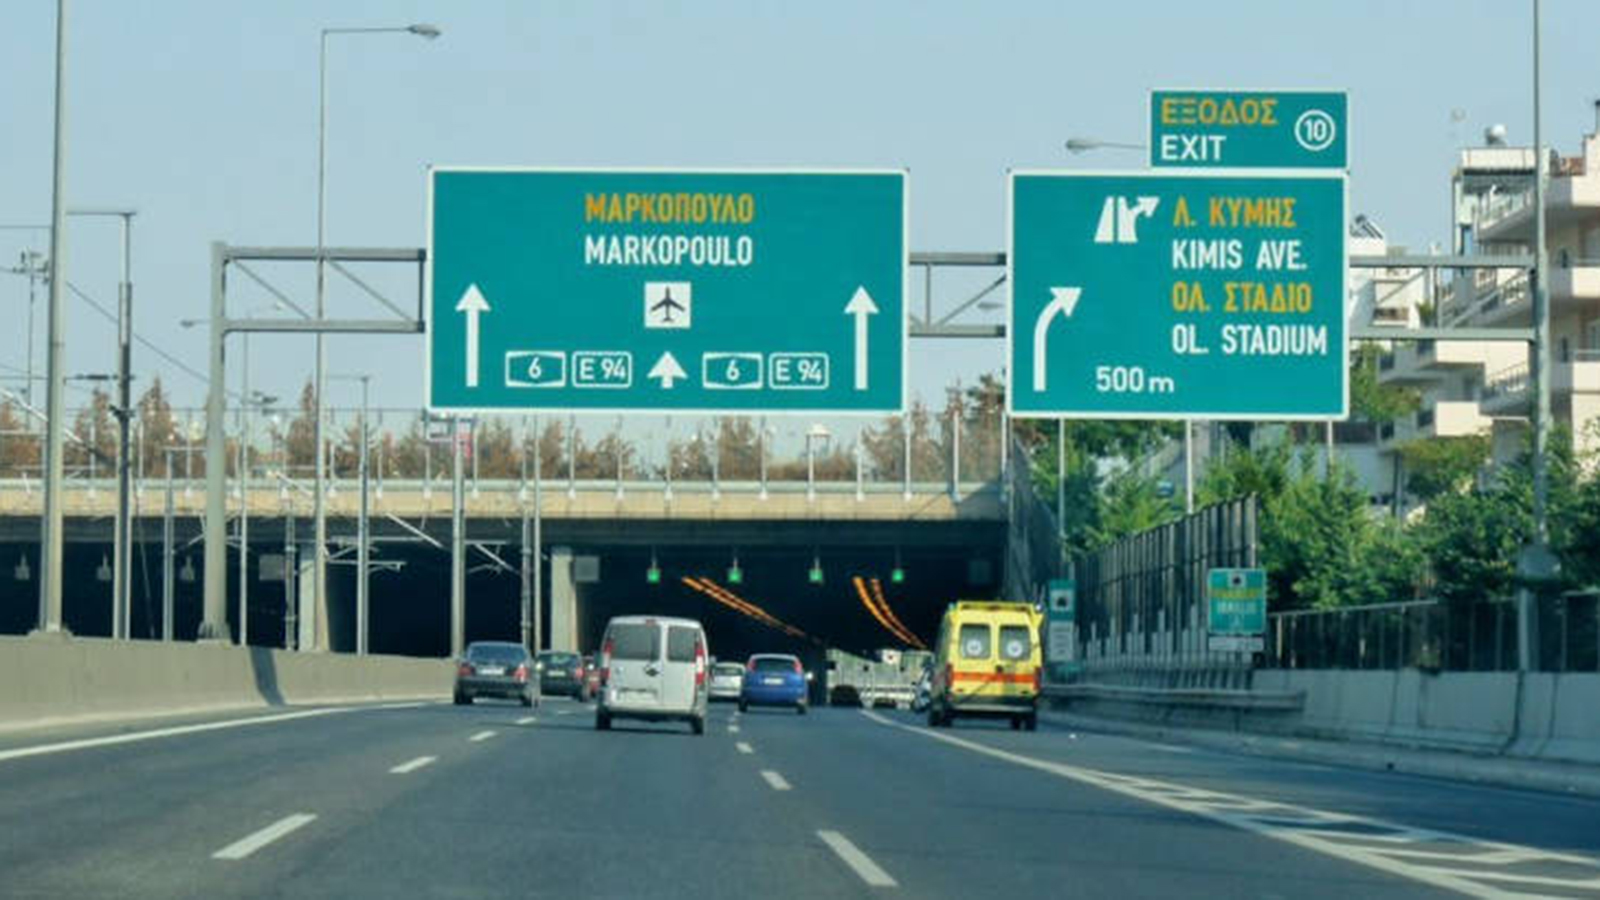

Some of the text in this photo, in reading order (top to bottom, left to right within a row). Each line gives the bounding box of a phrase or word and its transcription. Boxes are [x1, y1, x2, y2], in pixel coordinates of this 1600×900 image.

[1161, 98, 1278, 125] ΕΞΟΔΟΣ
[1304, 119, 1327, 141] 10
[1161, 134, 1226, 160] EXIT
[584, 192, 755, 224] ΜΑΡΚΟΠΟΥΛΟ
[1173, 196, 1297, 227] Λ. ΚΥΜΗΣ
[585, 235, 753, 266] MARKOPOULO
[1172, 239, 1307, 269] KIMIS AVE.
[1172, 282, 1312, 313] ΟΛ. ΣΤΑΔΙΟ
[1172, 324, 1327, 355] OL. STADIUM
[528, 358, 541, 379] 6
[580, 357, 626, 380] E 94
[726, 360, 740, 381] 6
[776, 360, 822, 381] E 94
[1096, 366, 1174, 393] 500 m
